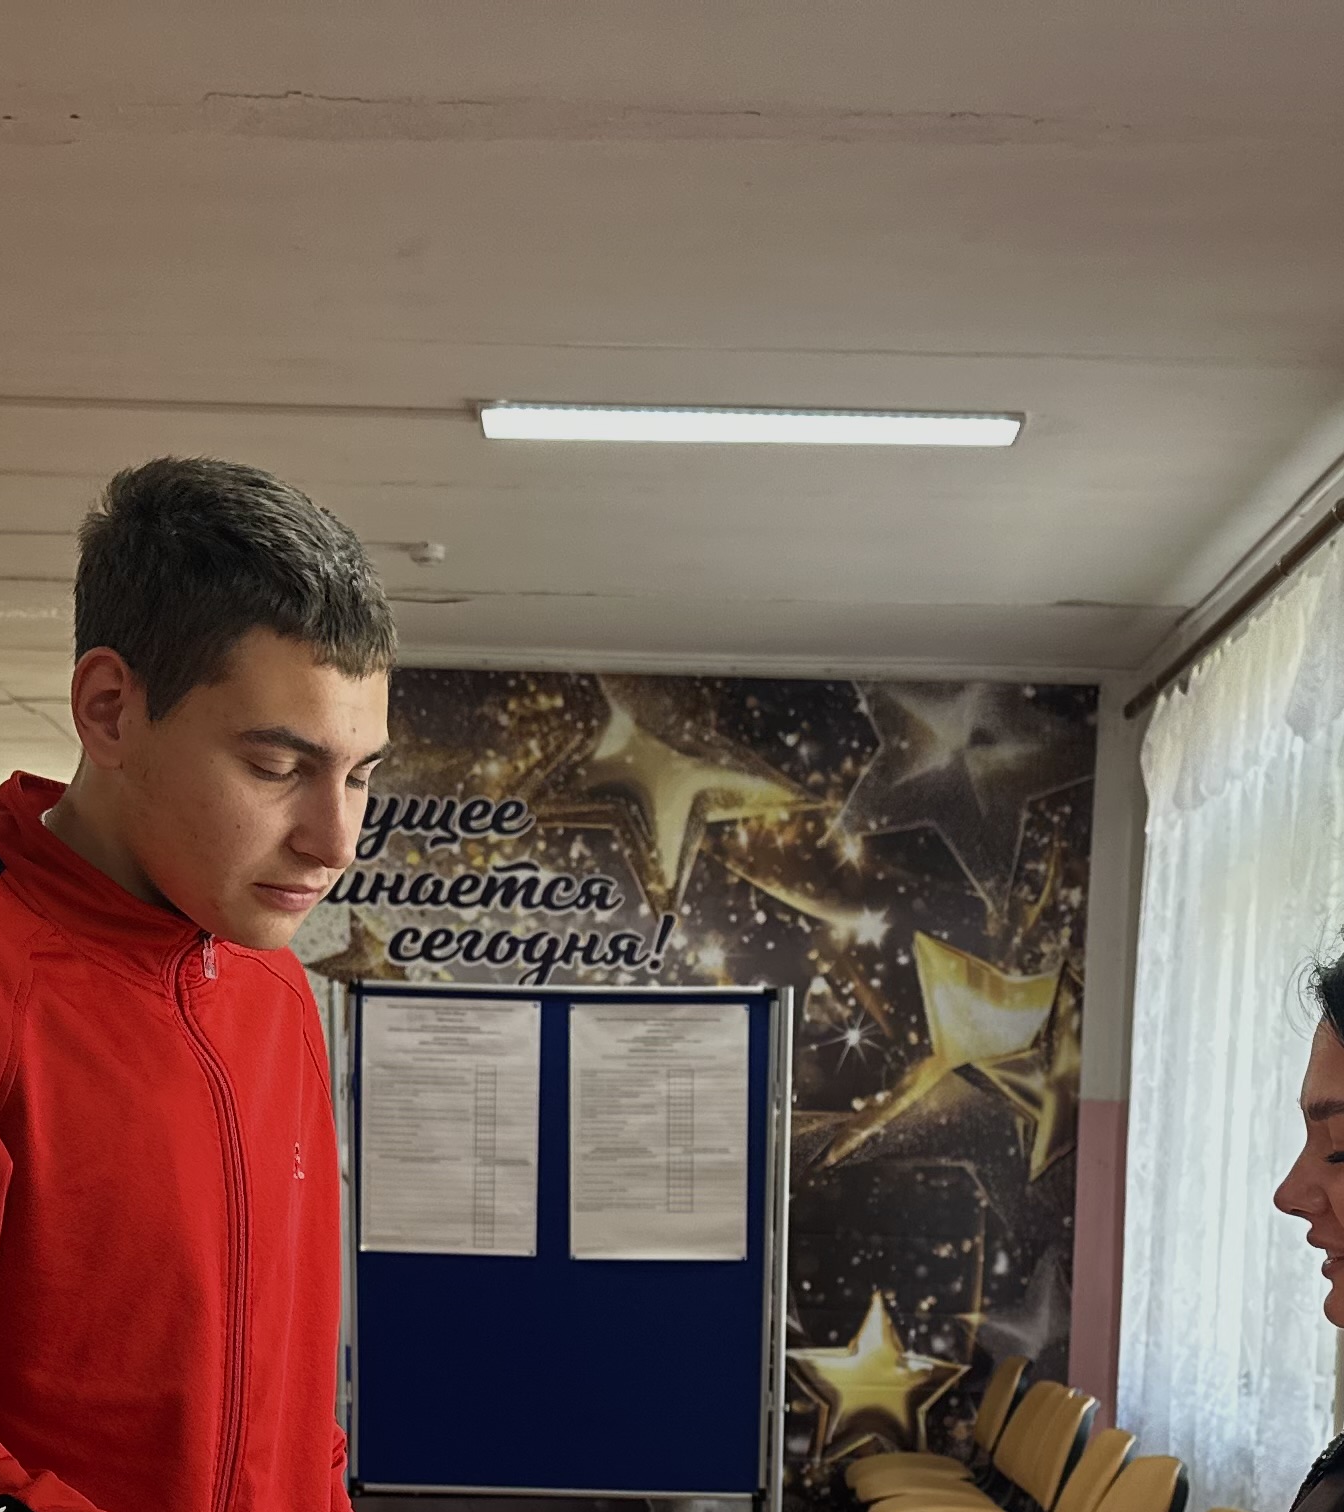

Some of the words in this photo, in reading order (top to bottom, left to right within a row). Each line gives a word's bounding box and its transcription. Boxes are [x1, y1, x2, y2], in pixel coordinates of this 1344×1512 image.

[356, 796, 534, 860] ущее
[325, 861, 624, 913] инается
[388, 914, 676, 986] сегодня!
